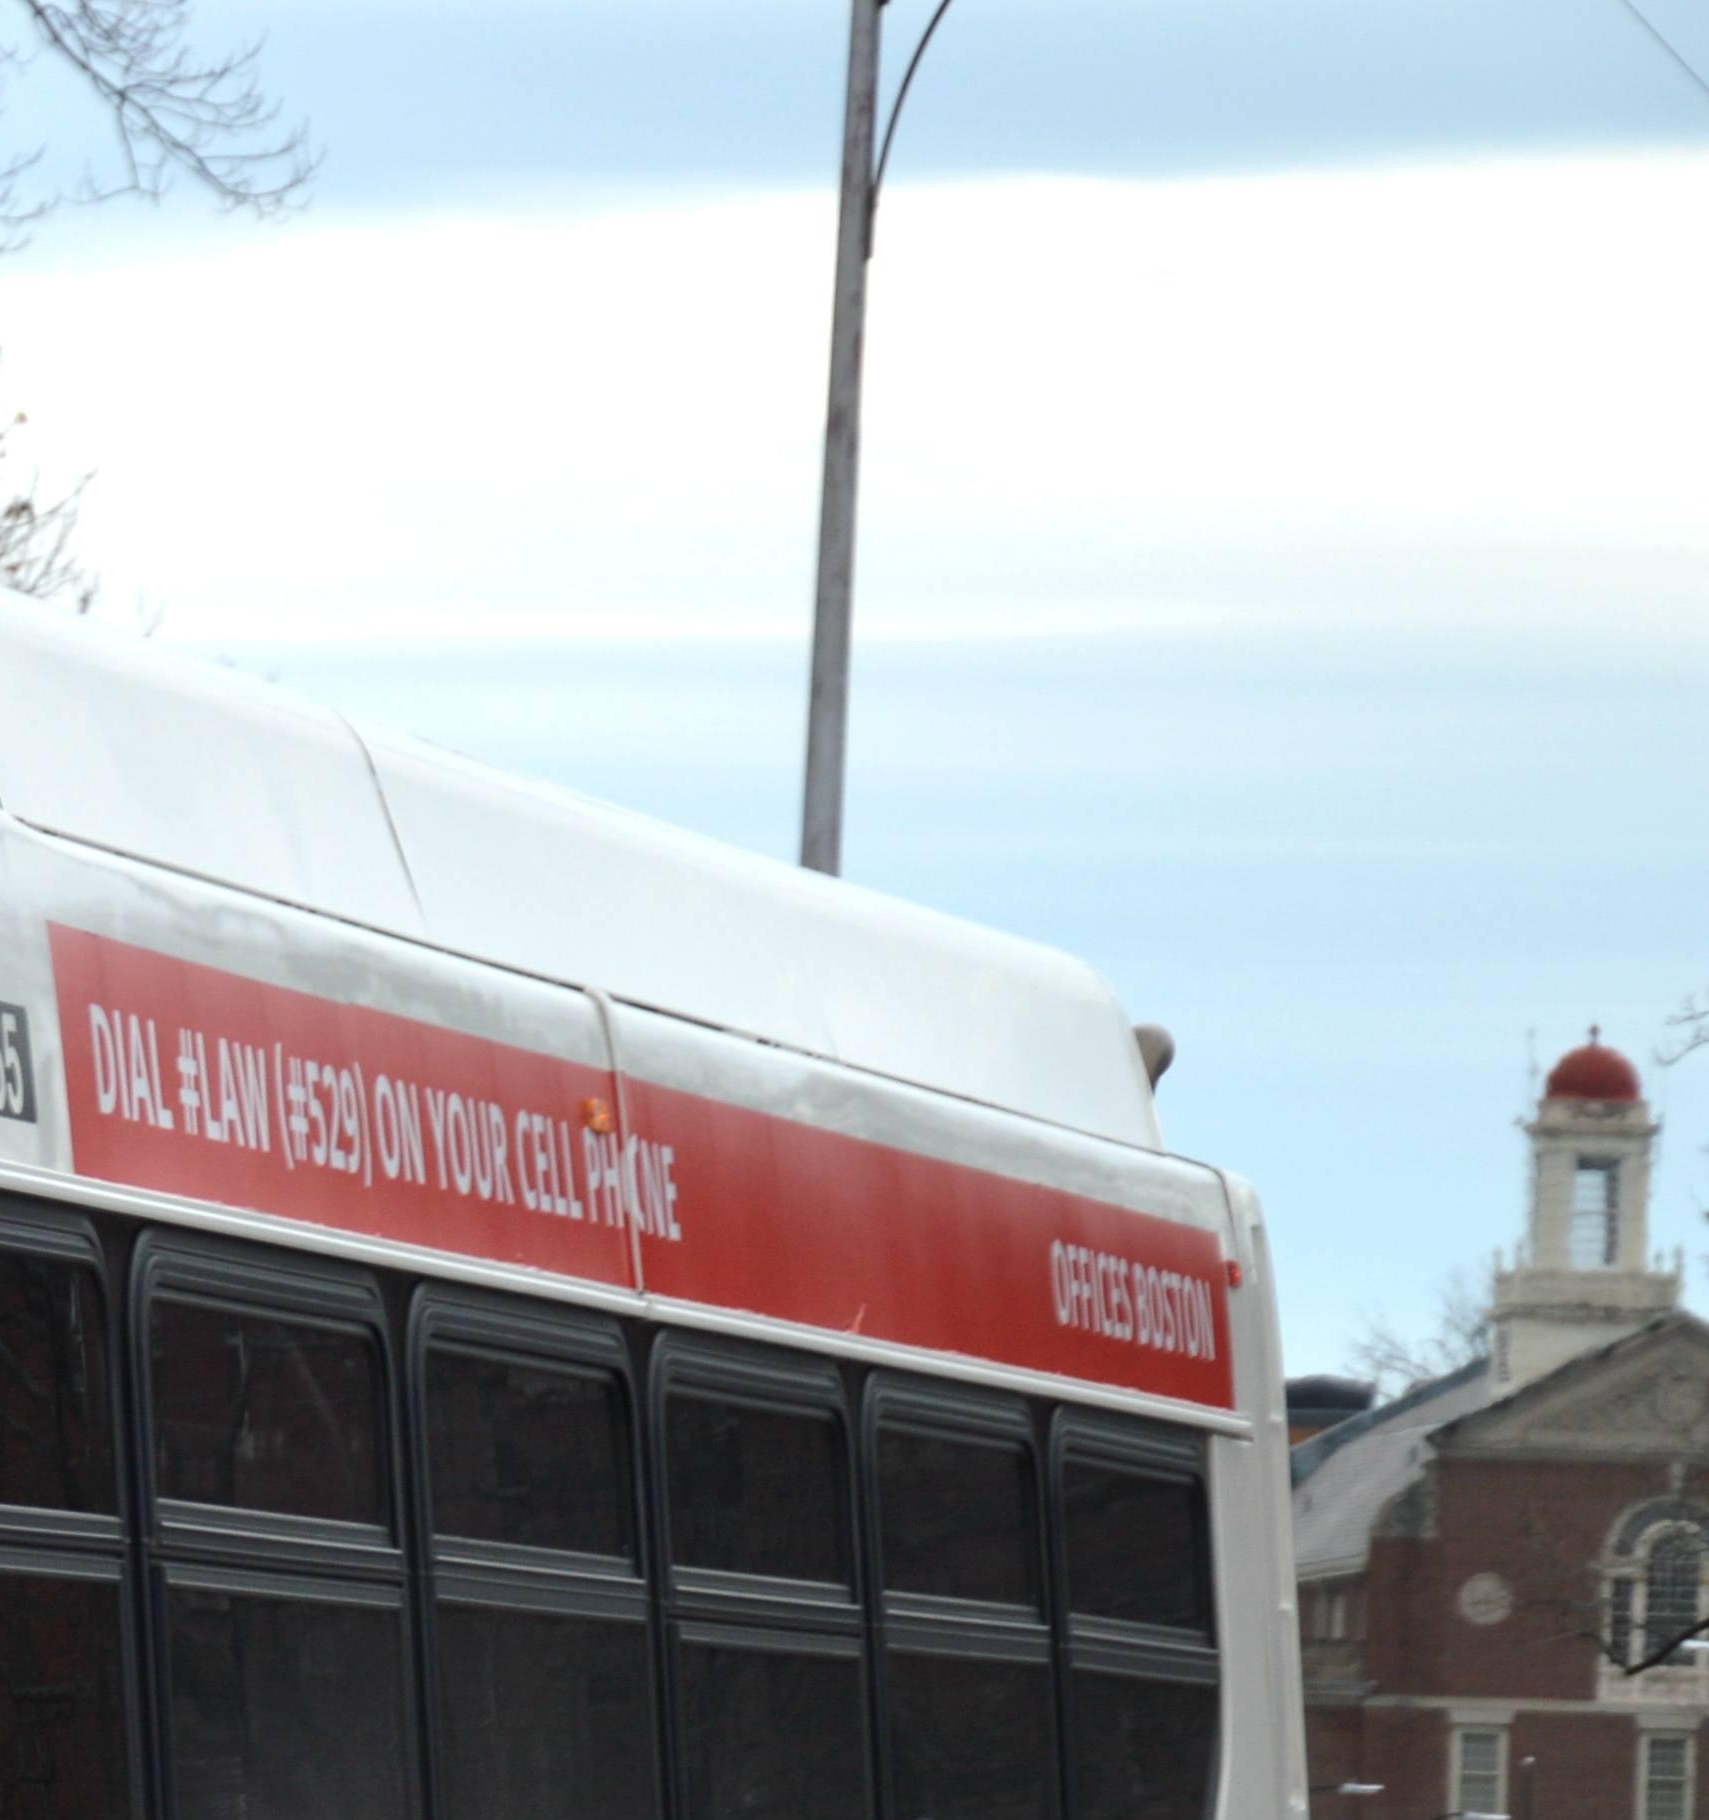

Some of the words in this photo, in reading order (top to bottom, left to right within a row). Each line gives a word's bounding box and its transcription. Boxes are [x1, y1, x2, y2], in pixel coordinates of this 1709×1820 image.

[88, 1003, 174, 1130] DIAL
[176, 1027, 270, 1152] #LAW
[274, 1042, 372, 1187] (#529)
[374, 1074, 426, 1185] ON
[425, 1087, 515, 1204] YOUR
[516, 1109, 583, 1220] CELL
[1051, 1238, 1132, 1341] OFFICES
[1133, 1262, 1216, 1361] BOSTON
